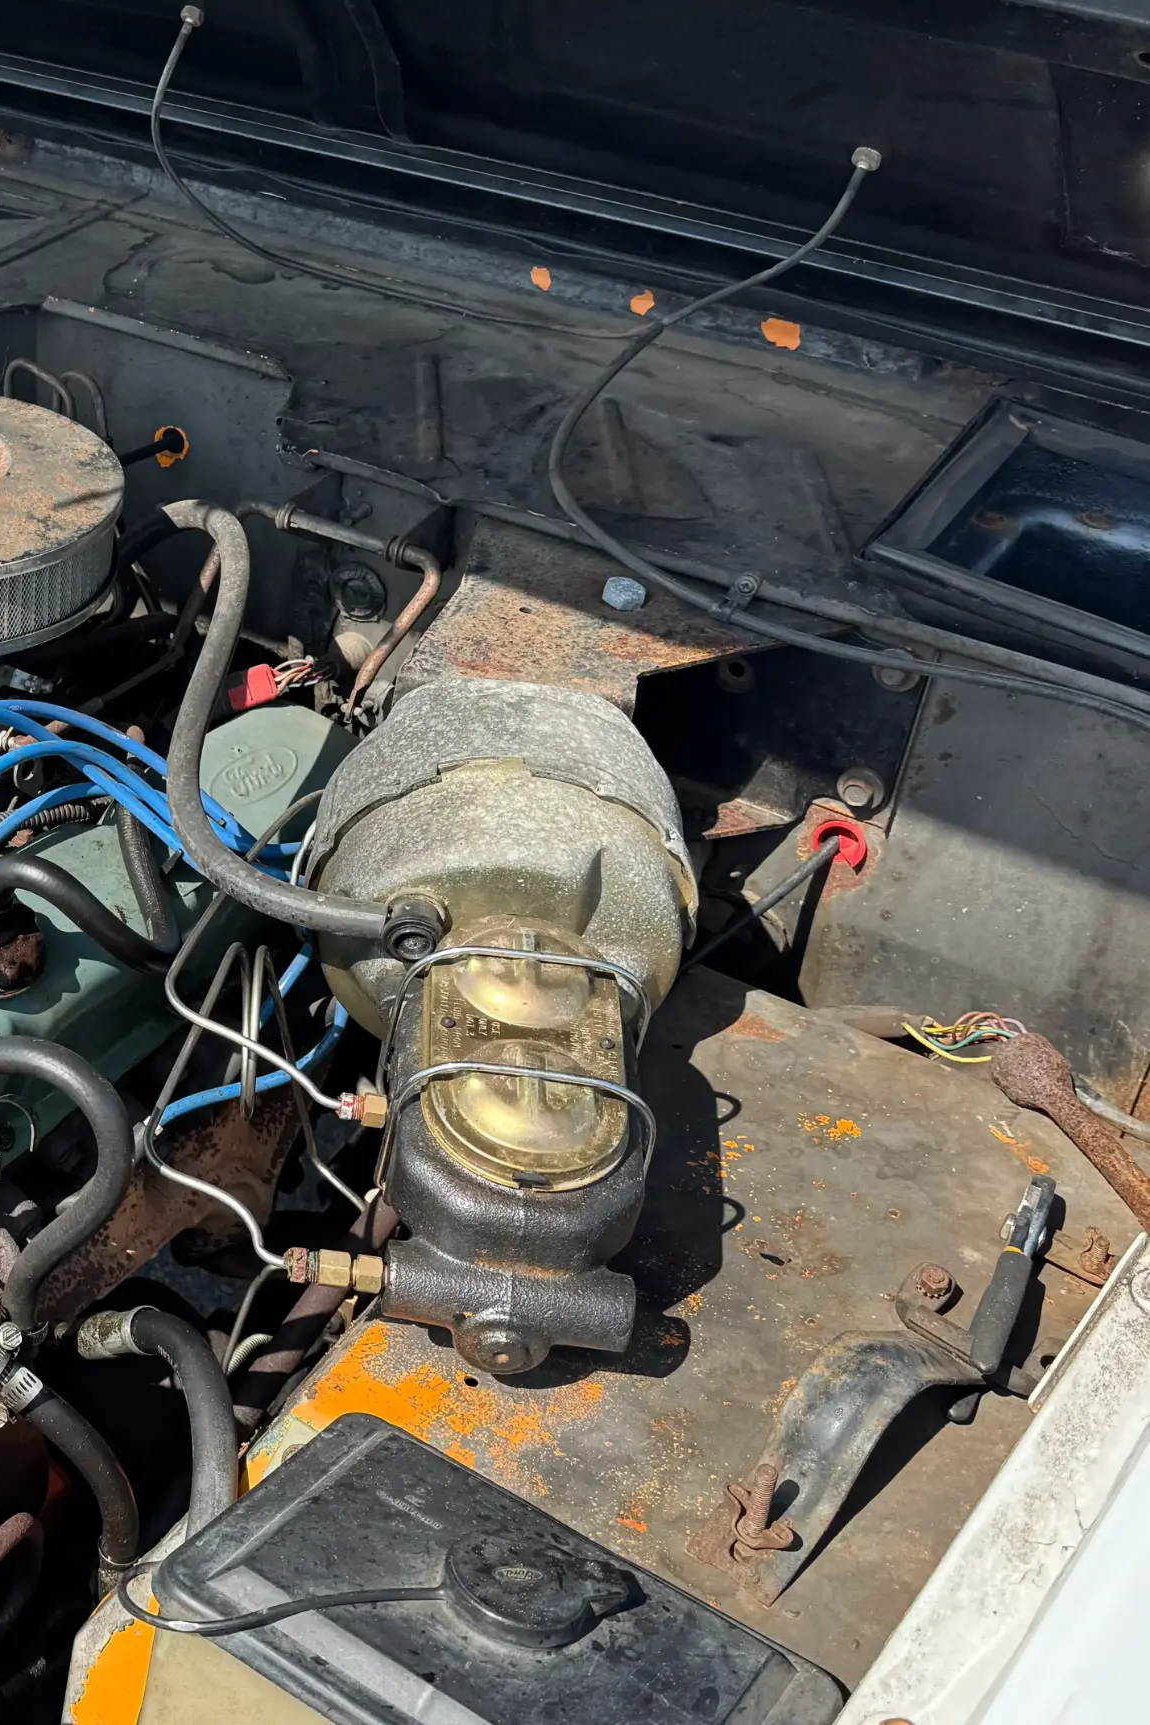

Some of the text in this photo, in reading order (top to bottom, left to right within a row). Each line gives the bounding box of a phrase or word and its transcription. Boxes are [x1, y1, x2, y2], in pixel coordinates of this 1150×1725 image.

[222, 753, 284, 800] Ford
[452, 999, 466, 1048] FLUID FROM
[465, 1013, 475, 1028] DOT
[478, 1017, 488, 1036] ONLY
[491, 1021, 501, 1036] USE
